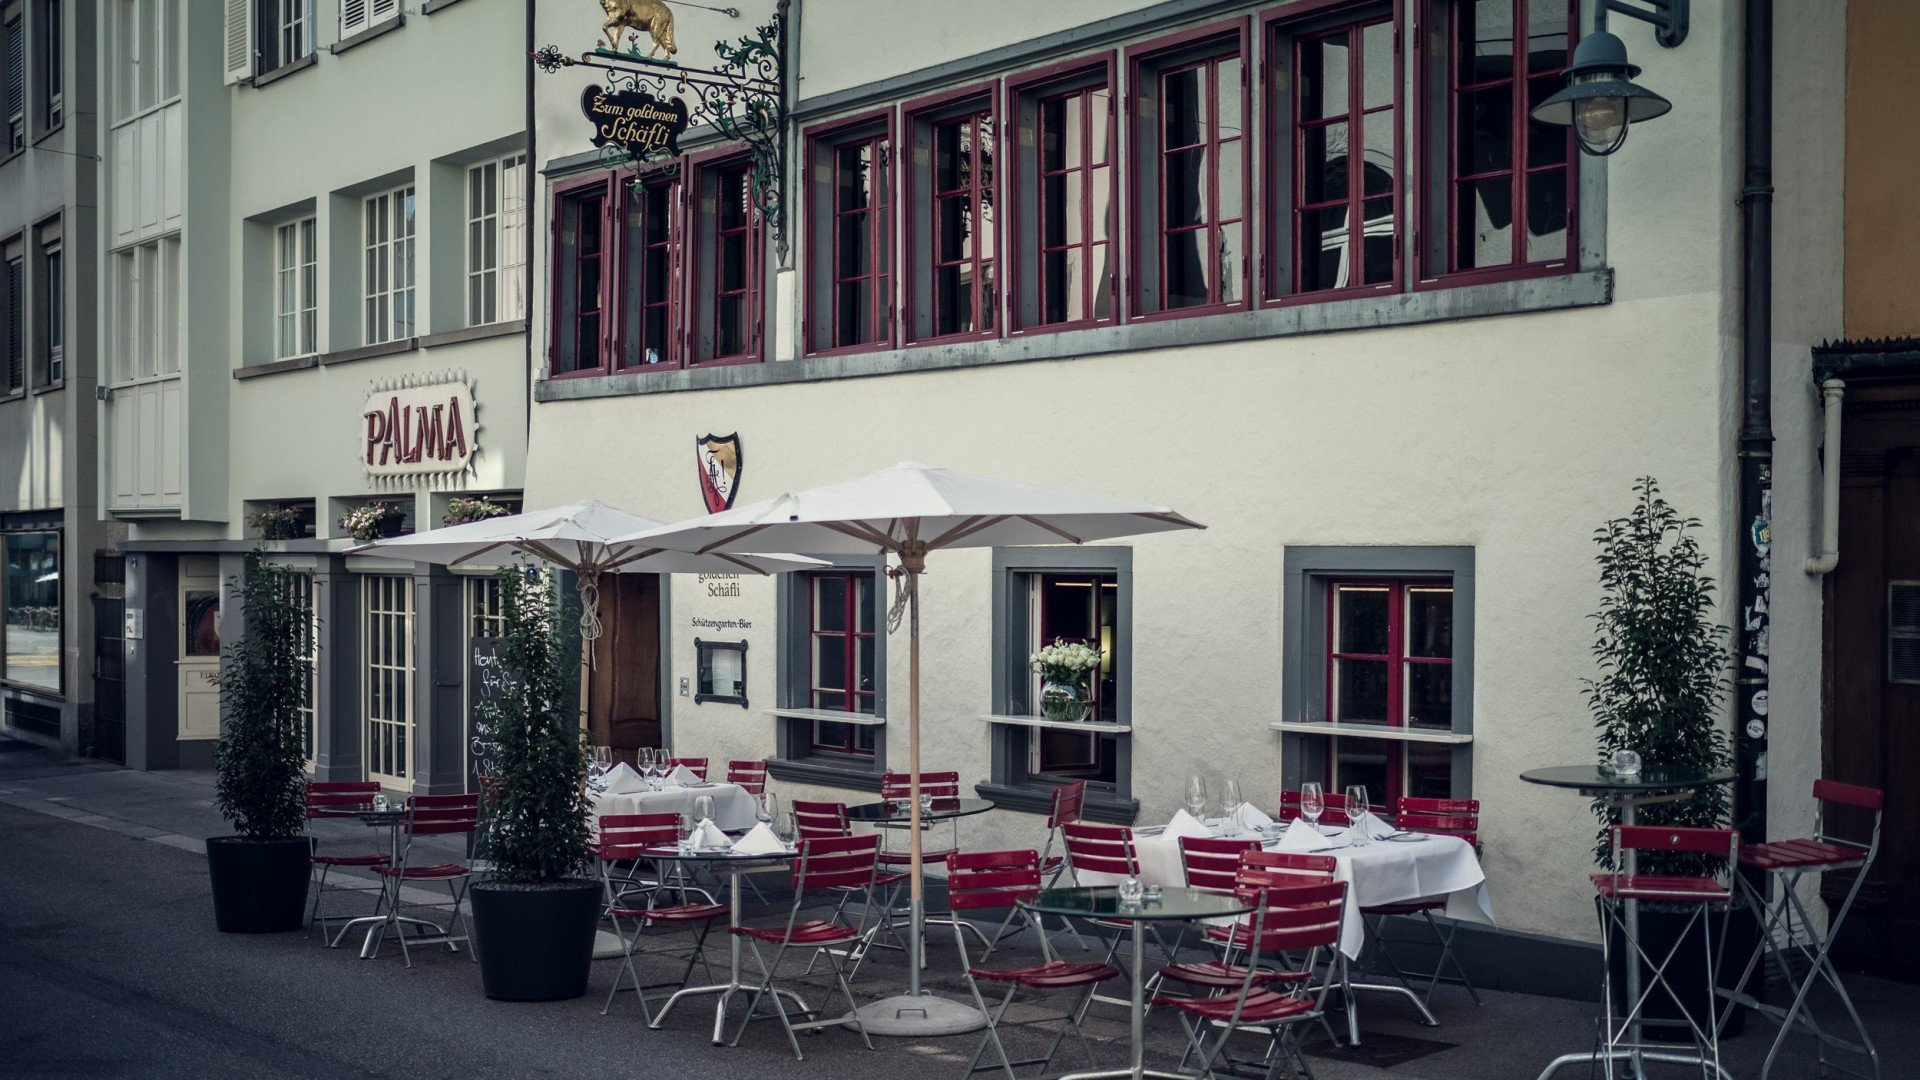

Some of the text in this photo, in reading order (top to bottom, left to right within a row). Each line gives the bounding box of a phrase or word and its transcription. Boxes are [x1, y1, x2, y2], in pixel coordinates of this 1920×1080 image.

[592, 93, 678, 123] Zum goldenen
[601, 117, 671, 152] Schäfli
[363, 396, 467, 466] PALMA
[708, 583, 740, 596] Schäfli
[692, 617, 752, 631] Schützengarten-Bier
